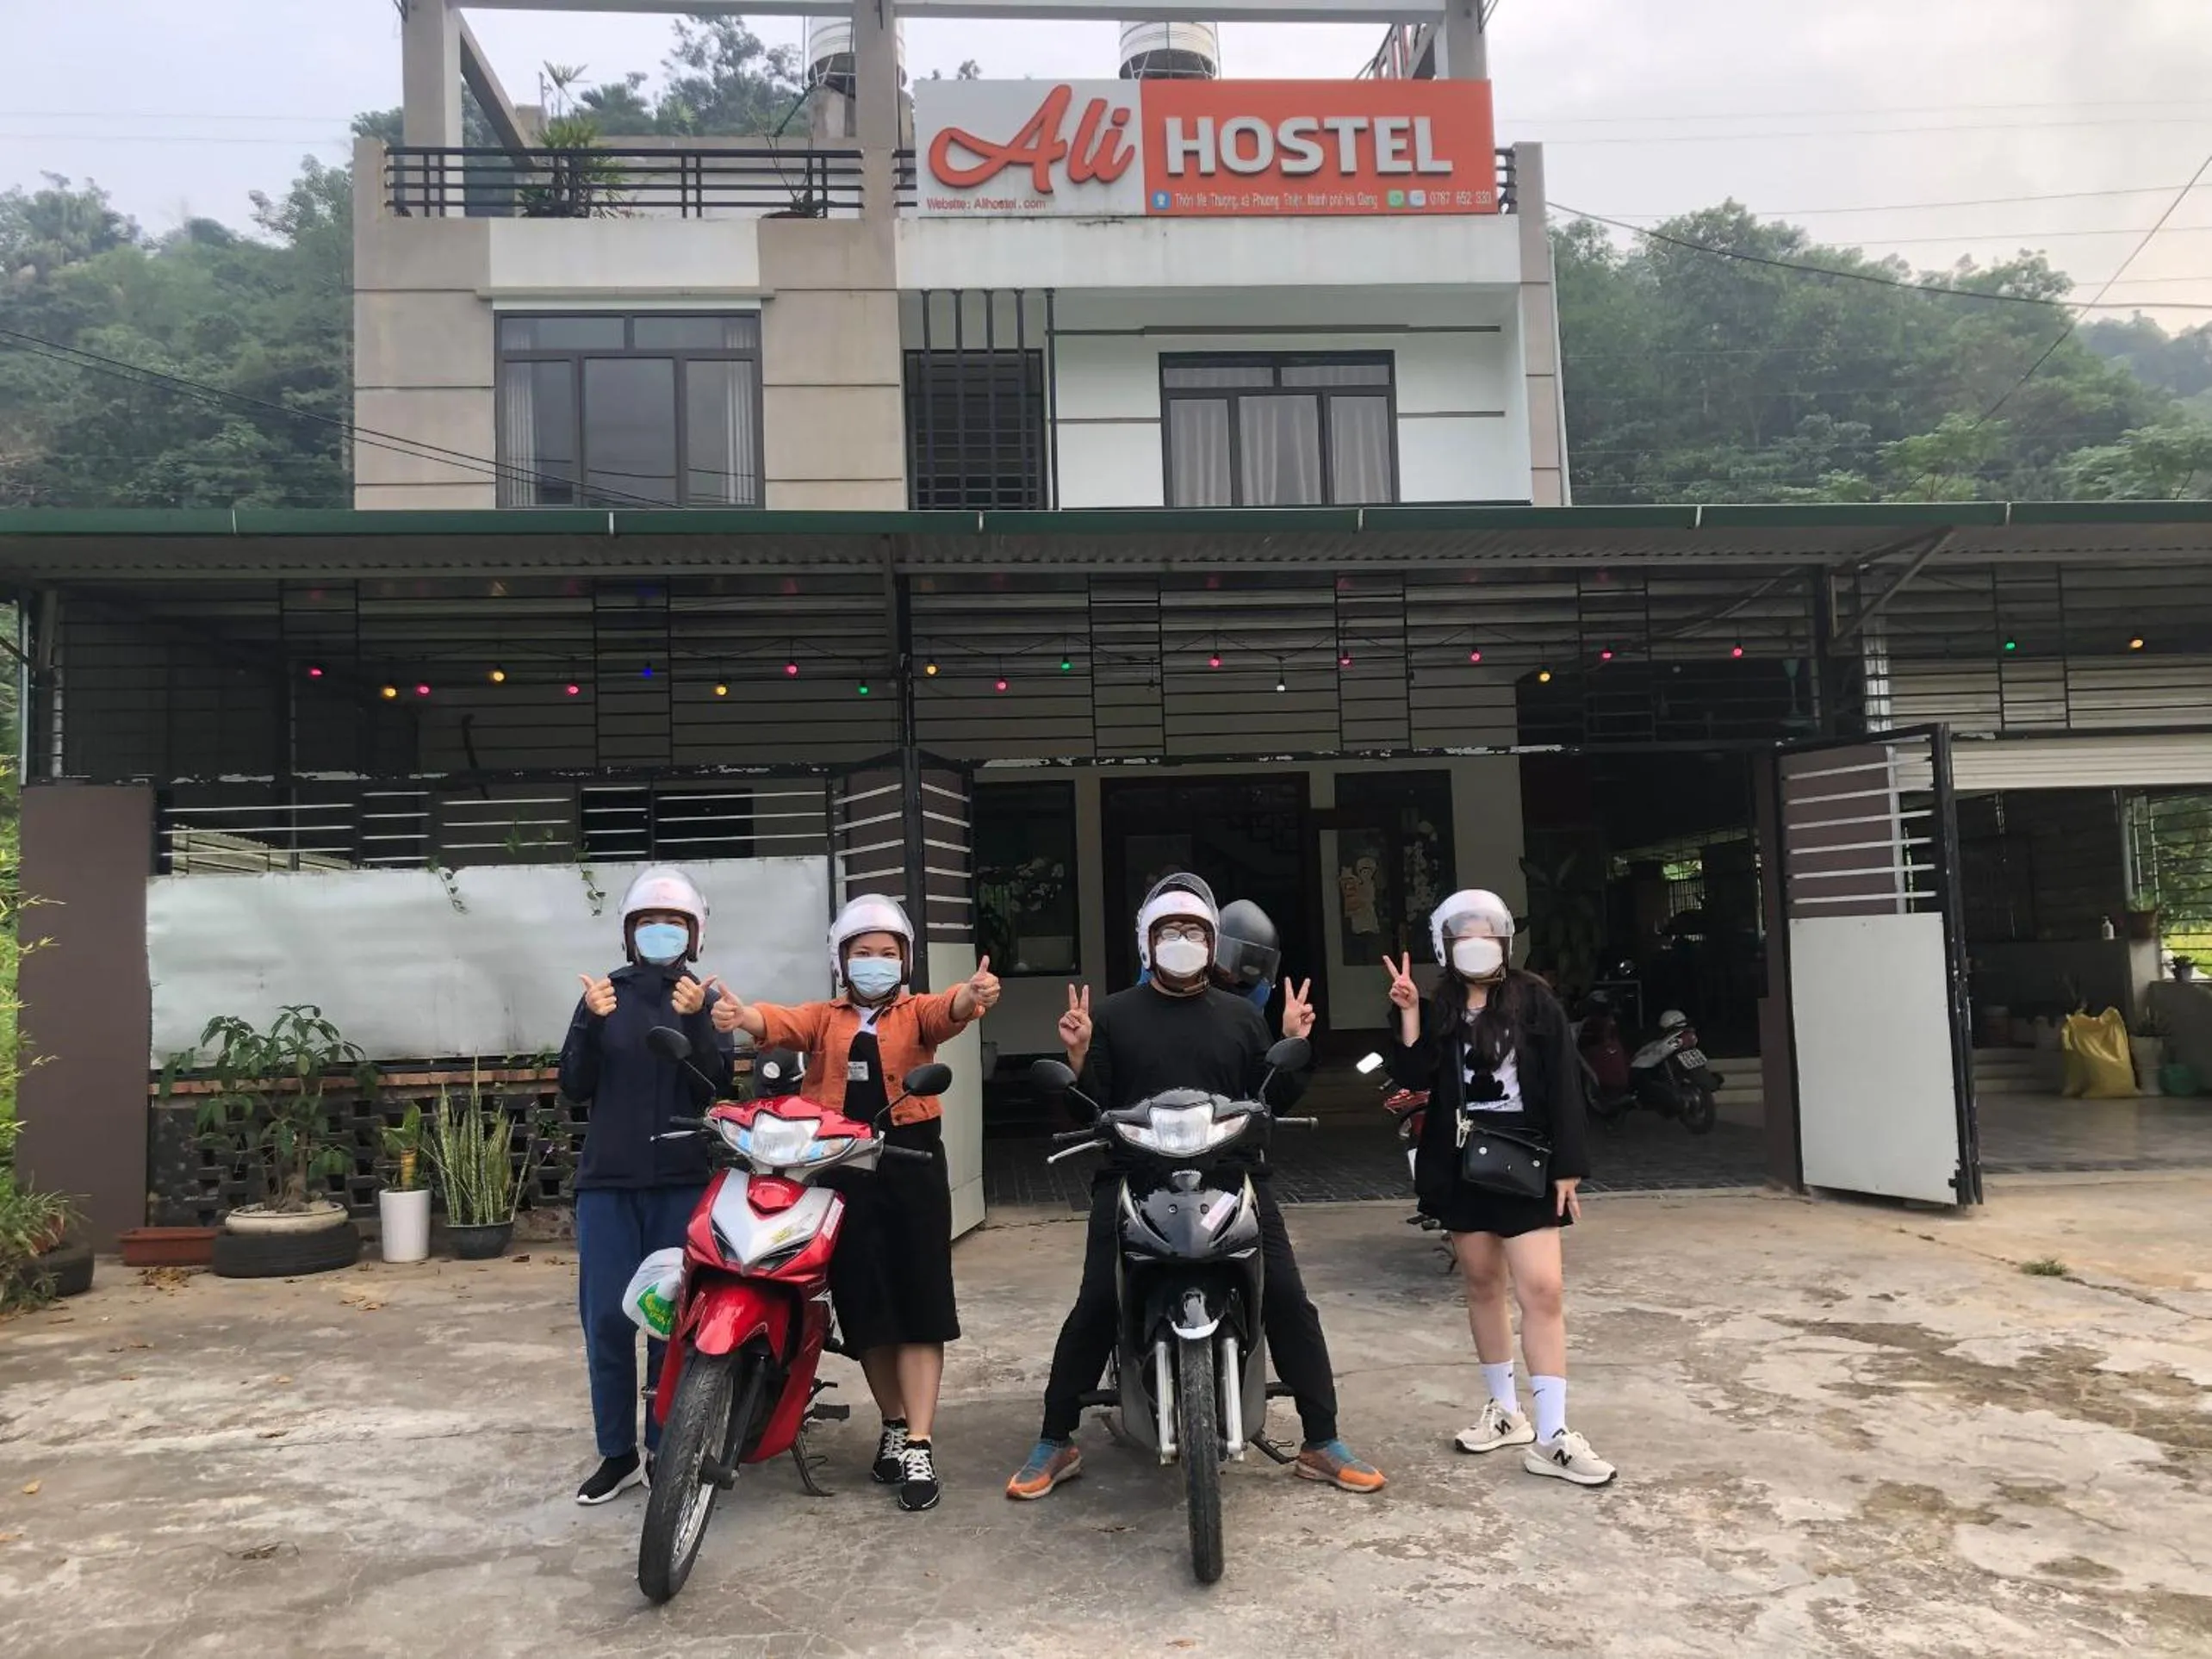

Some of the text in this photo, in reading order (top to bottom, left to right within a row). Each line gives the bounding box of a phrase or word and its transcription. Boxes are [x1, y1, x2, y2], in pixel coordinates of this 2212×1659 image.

[929, 84, 1453, 194] Ali HOSTEL
[926, 197, 971, 210] Website:
